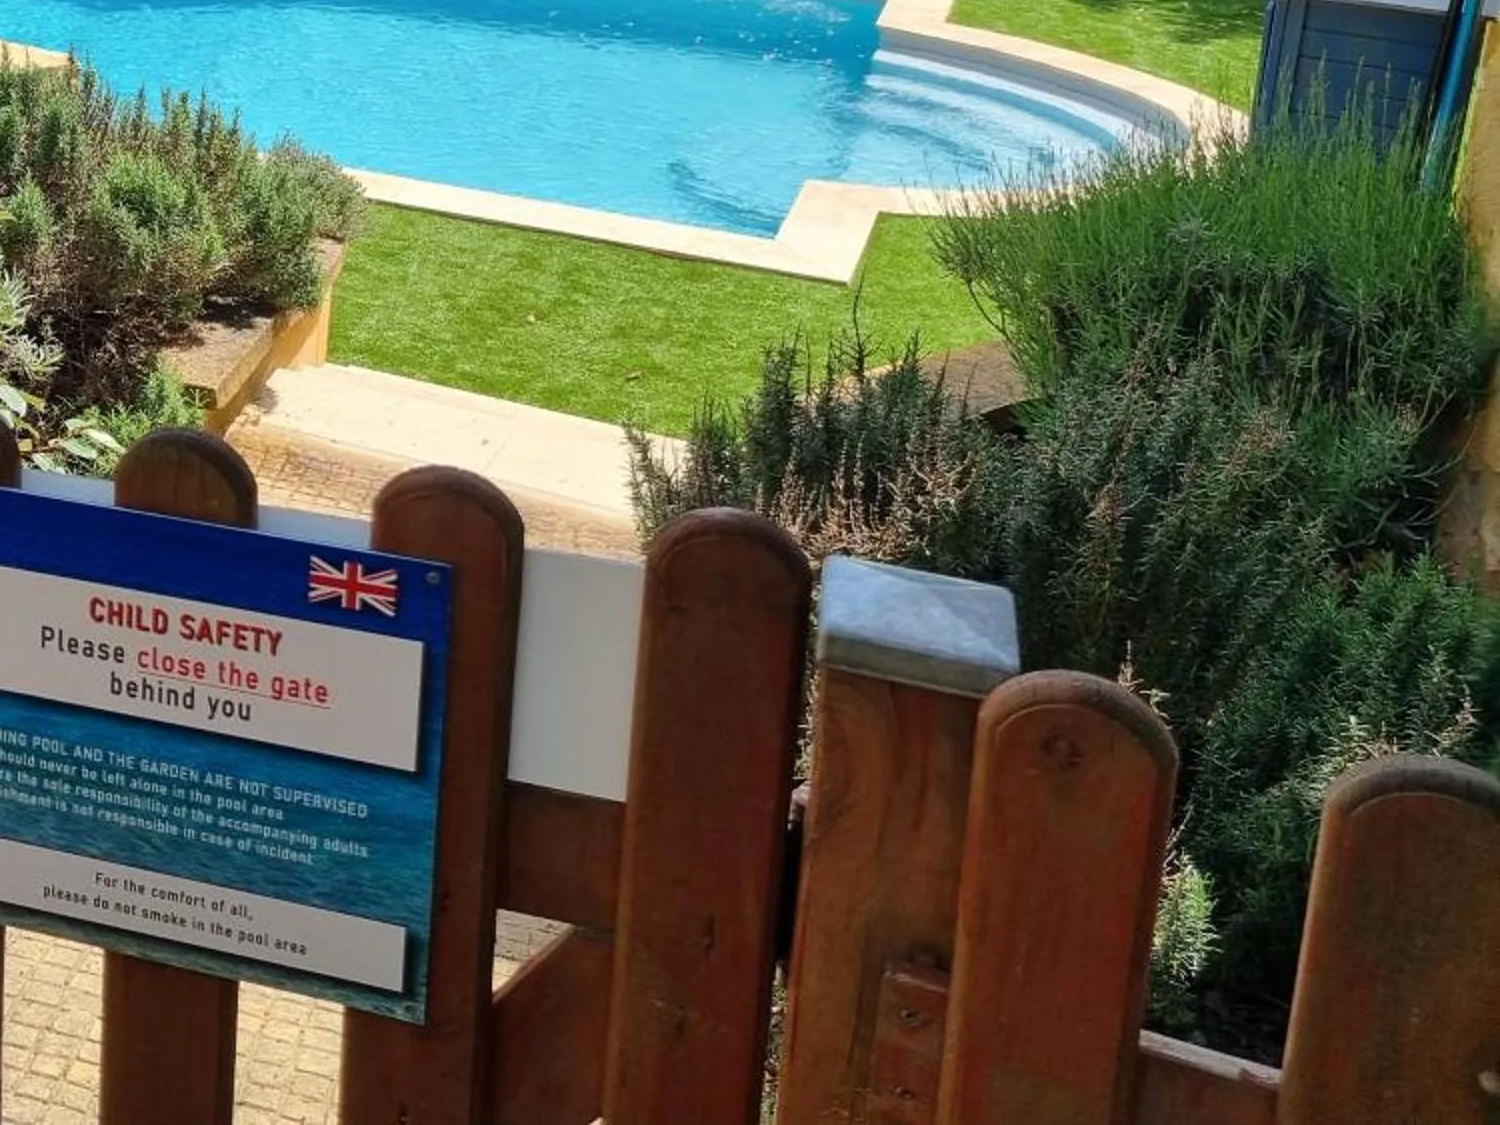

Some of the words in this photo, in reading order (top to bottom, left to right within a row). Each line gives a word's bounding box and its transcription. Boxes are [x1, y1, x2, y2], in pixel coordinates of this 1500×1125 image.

[89, 596, 168, 635] CHILD
[179, 613, 283, 657] SAFETY
[41, 626, 125, 663] Please
[137, 646, 205, 679] close
[219, 661, 258, 690] the
[271, 675, 329, 703] gate
[110, 671, 195, 710] behind
[207, 695, 251, 722] you
[32, 736, 68, 755] POOL
[73, 744, 103, 762] AND
[108, 751, 134, 770] THE
[140, 758, 199, 783] GARDEN
[204, 771, 233, 790] ARE
[239, 779, 268, 797] NOT
[273, 786, 368, 818] SUPERVISED
[40, 759, 77, 775] never
[81, 765, 98, 780] be
[102, 769, 125, 787] left
[130, 777, 167, 795] alone
[172, 784, 185, 798] in
[190, 787, 212, 804] the
[217, 795, 247, 812] pool
[252, 805, 283, 821] area
[17, 770, 38, 787] the
[43, 777, 70, 793] sole
[75, 786, 168, 817] responsibility
[173, 803, 187, 817] of
[191, 807, 212, 824] the
[218, 815, 317, 850] accompanying
[323, 836, 368, 857] adults
[55, 798, 67, 812] is
[72, 802, 93, 817] not
[97, 809, 178, 835] responsible
[183, 826, 195, 840] in
[200, 832, 232, 848] case
[238, 838, 251, 851] of
[43, 884, 87, 905] please
[93, 894, 109, 910] do
[115, 900, 136, 916] not
[142, 906, 187, 928] smoke
[191, 917, 205, 932] in
[210, 921, 232, 939] the
[237, 929, 268, 947] pool
[274, 939, 307, 956] area
[95, 872, 118, 888] For
[123, 878, 145, 895] the
[151, 886, 206, 908] comfort
[211, 898, 224, 912] of
